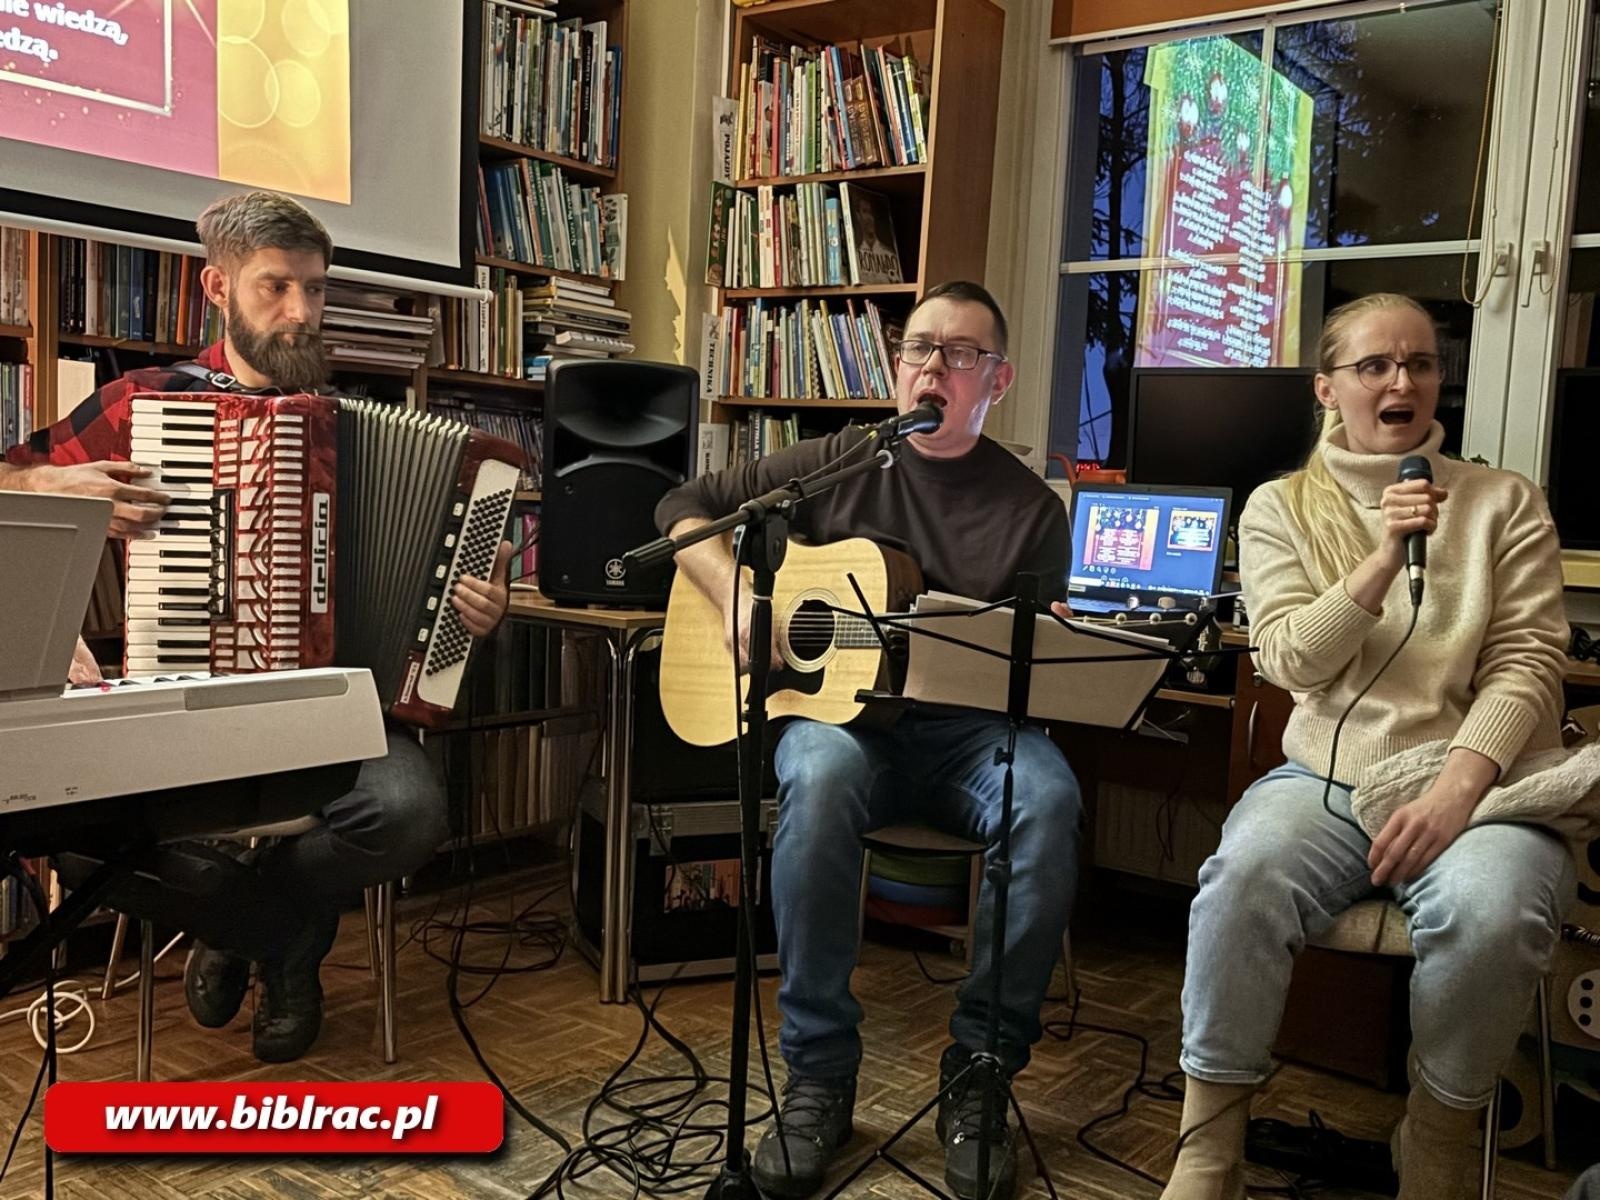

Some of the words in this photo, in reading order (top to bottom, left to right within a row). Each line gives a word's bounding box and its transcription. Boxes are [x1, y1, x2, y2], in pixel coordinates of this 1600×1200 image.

[723, 133, 731, 180] POJAZDY
[706, 342, 716, 393] TECHNIKA
[313, 500, 328, 604] delicia
